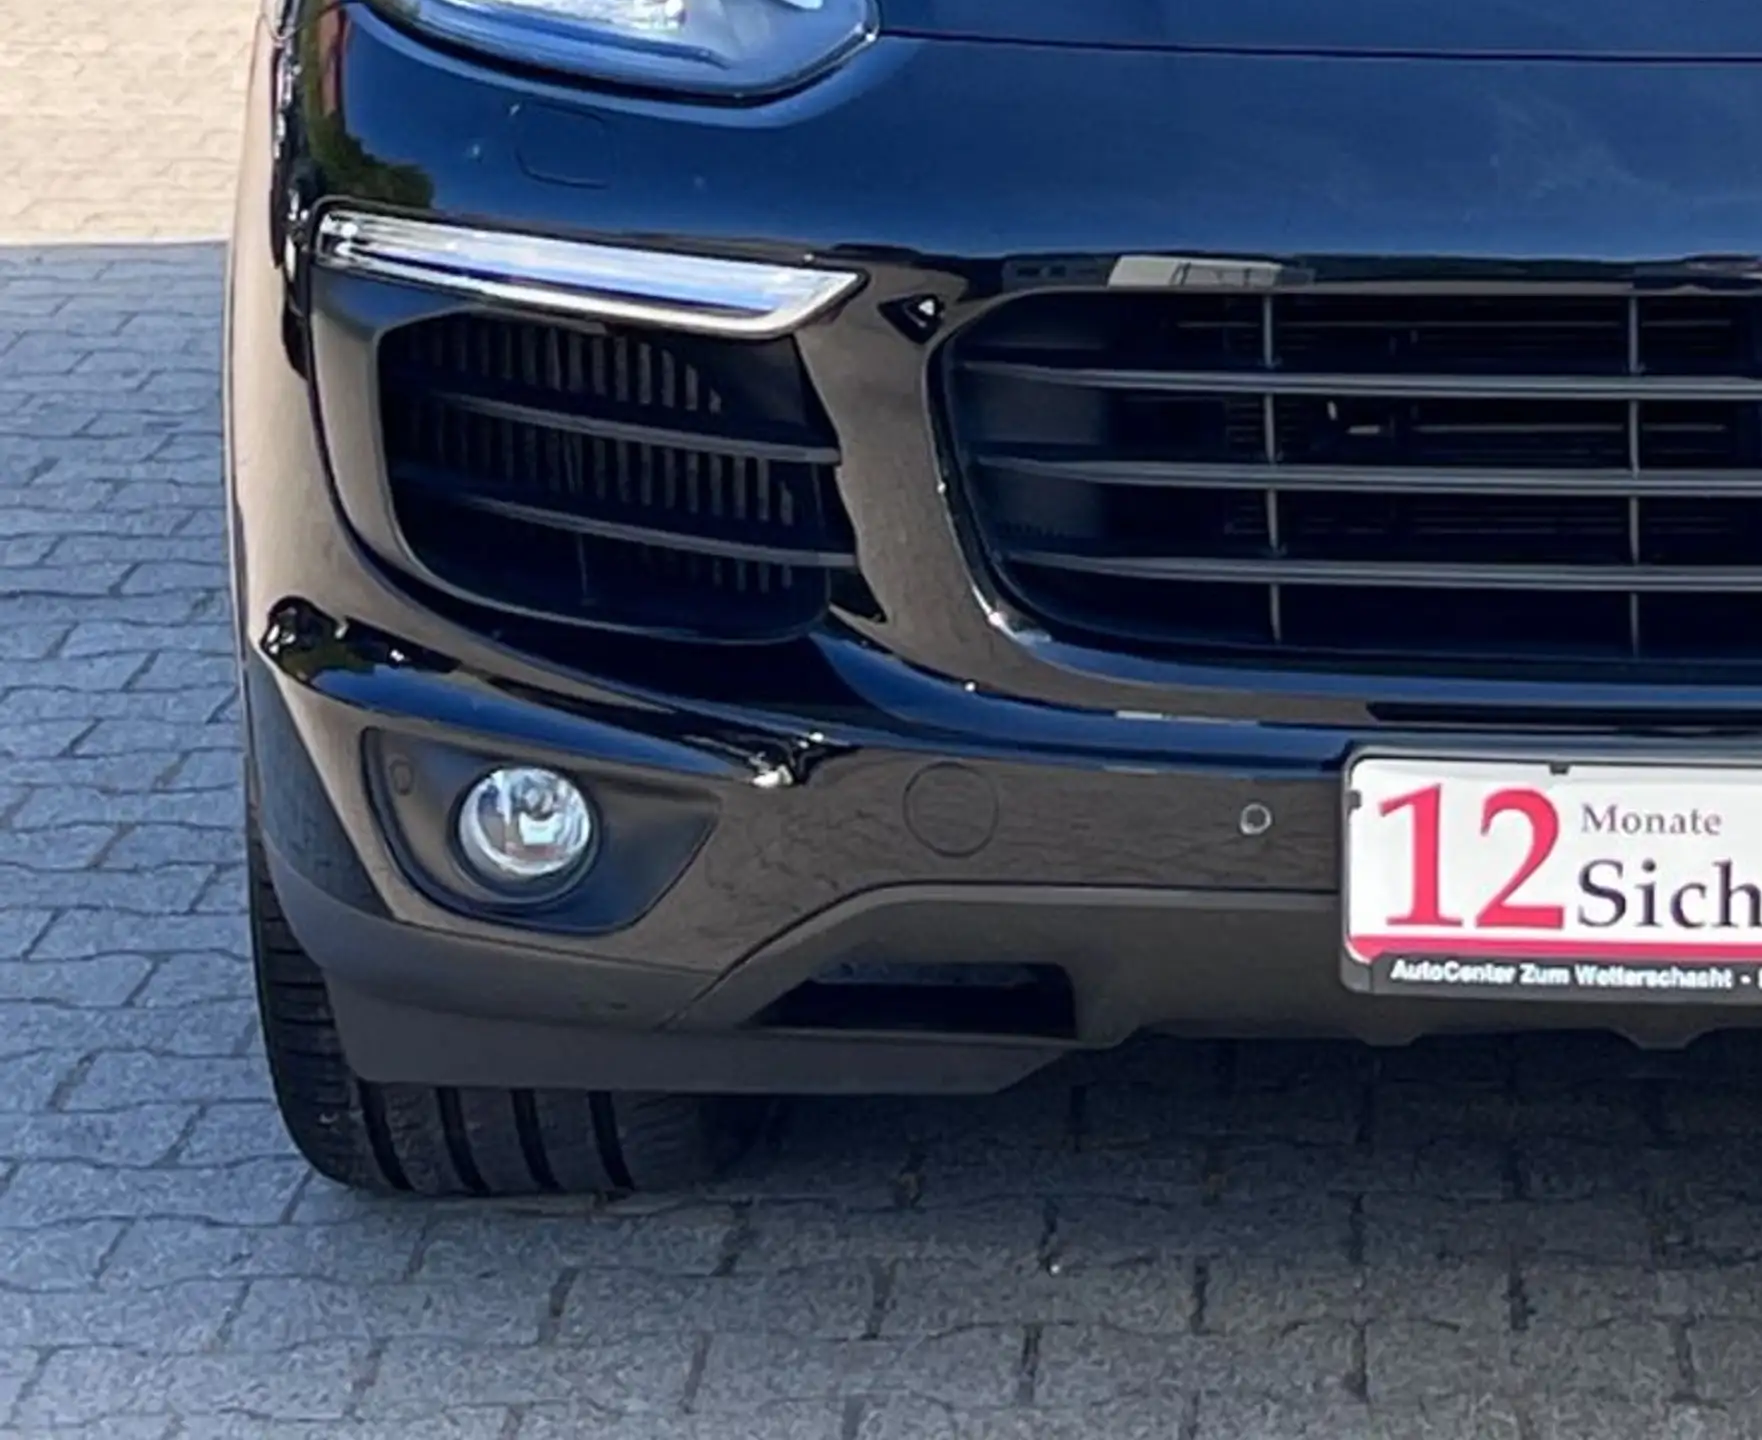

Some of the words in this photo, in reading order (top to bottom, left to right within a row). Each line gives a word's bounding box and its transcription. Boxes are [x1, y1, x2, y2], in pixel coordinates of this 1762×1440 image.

[1581, 803, 1721, 836] Monate
[1379, 783, 1564, 929] 12
[1390, 959, 1516, 984] AutoCenter
[1519, 962, 1570, 985] Zum
